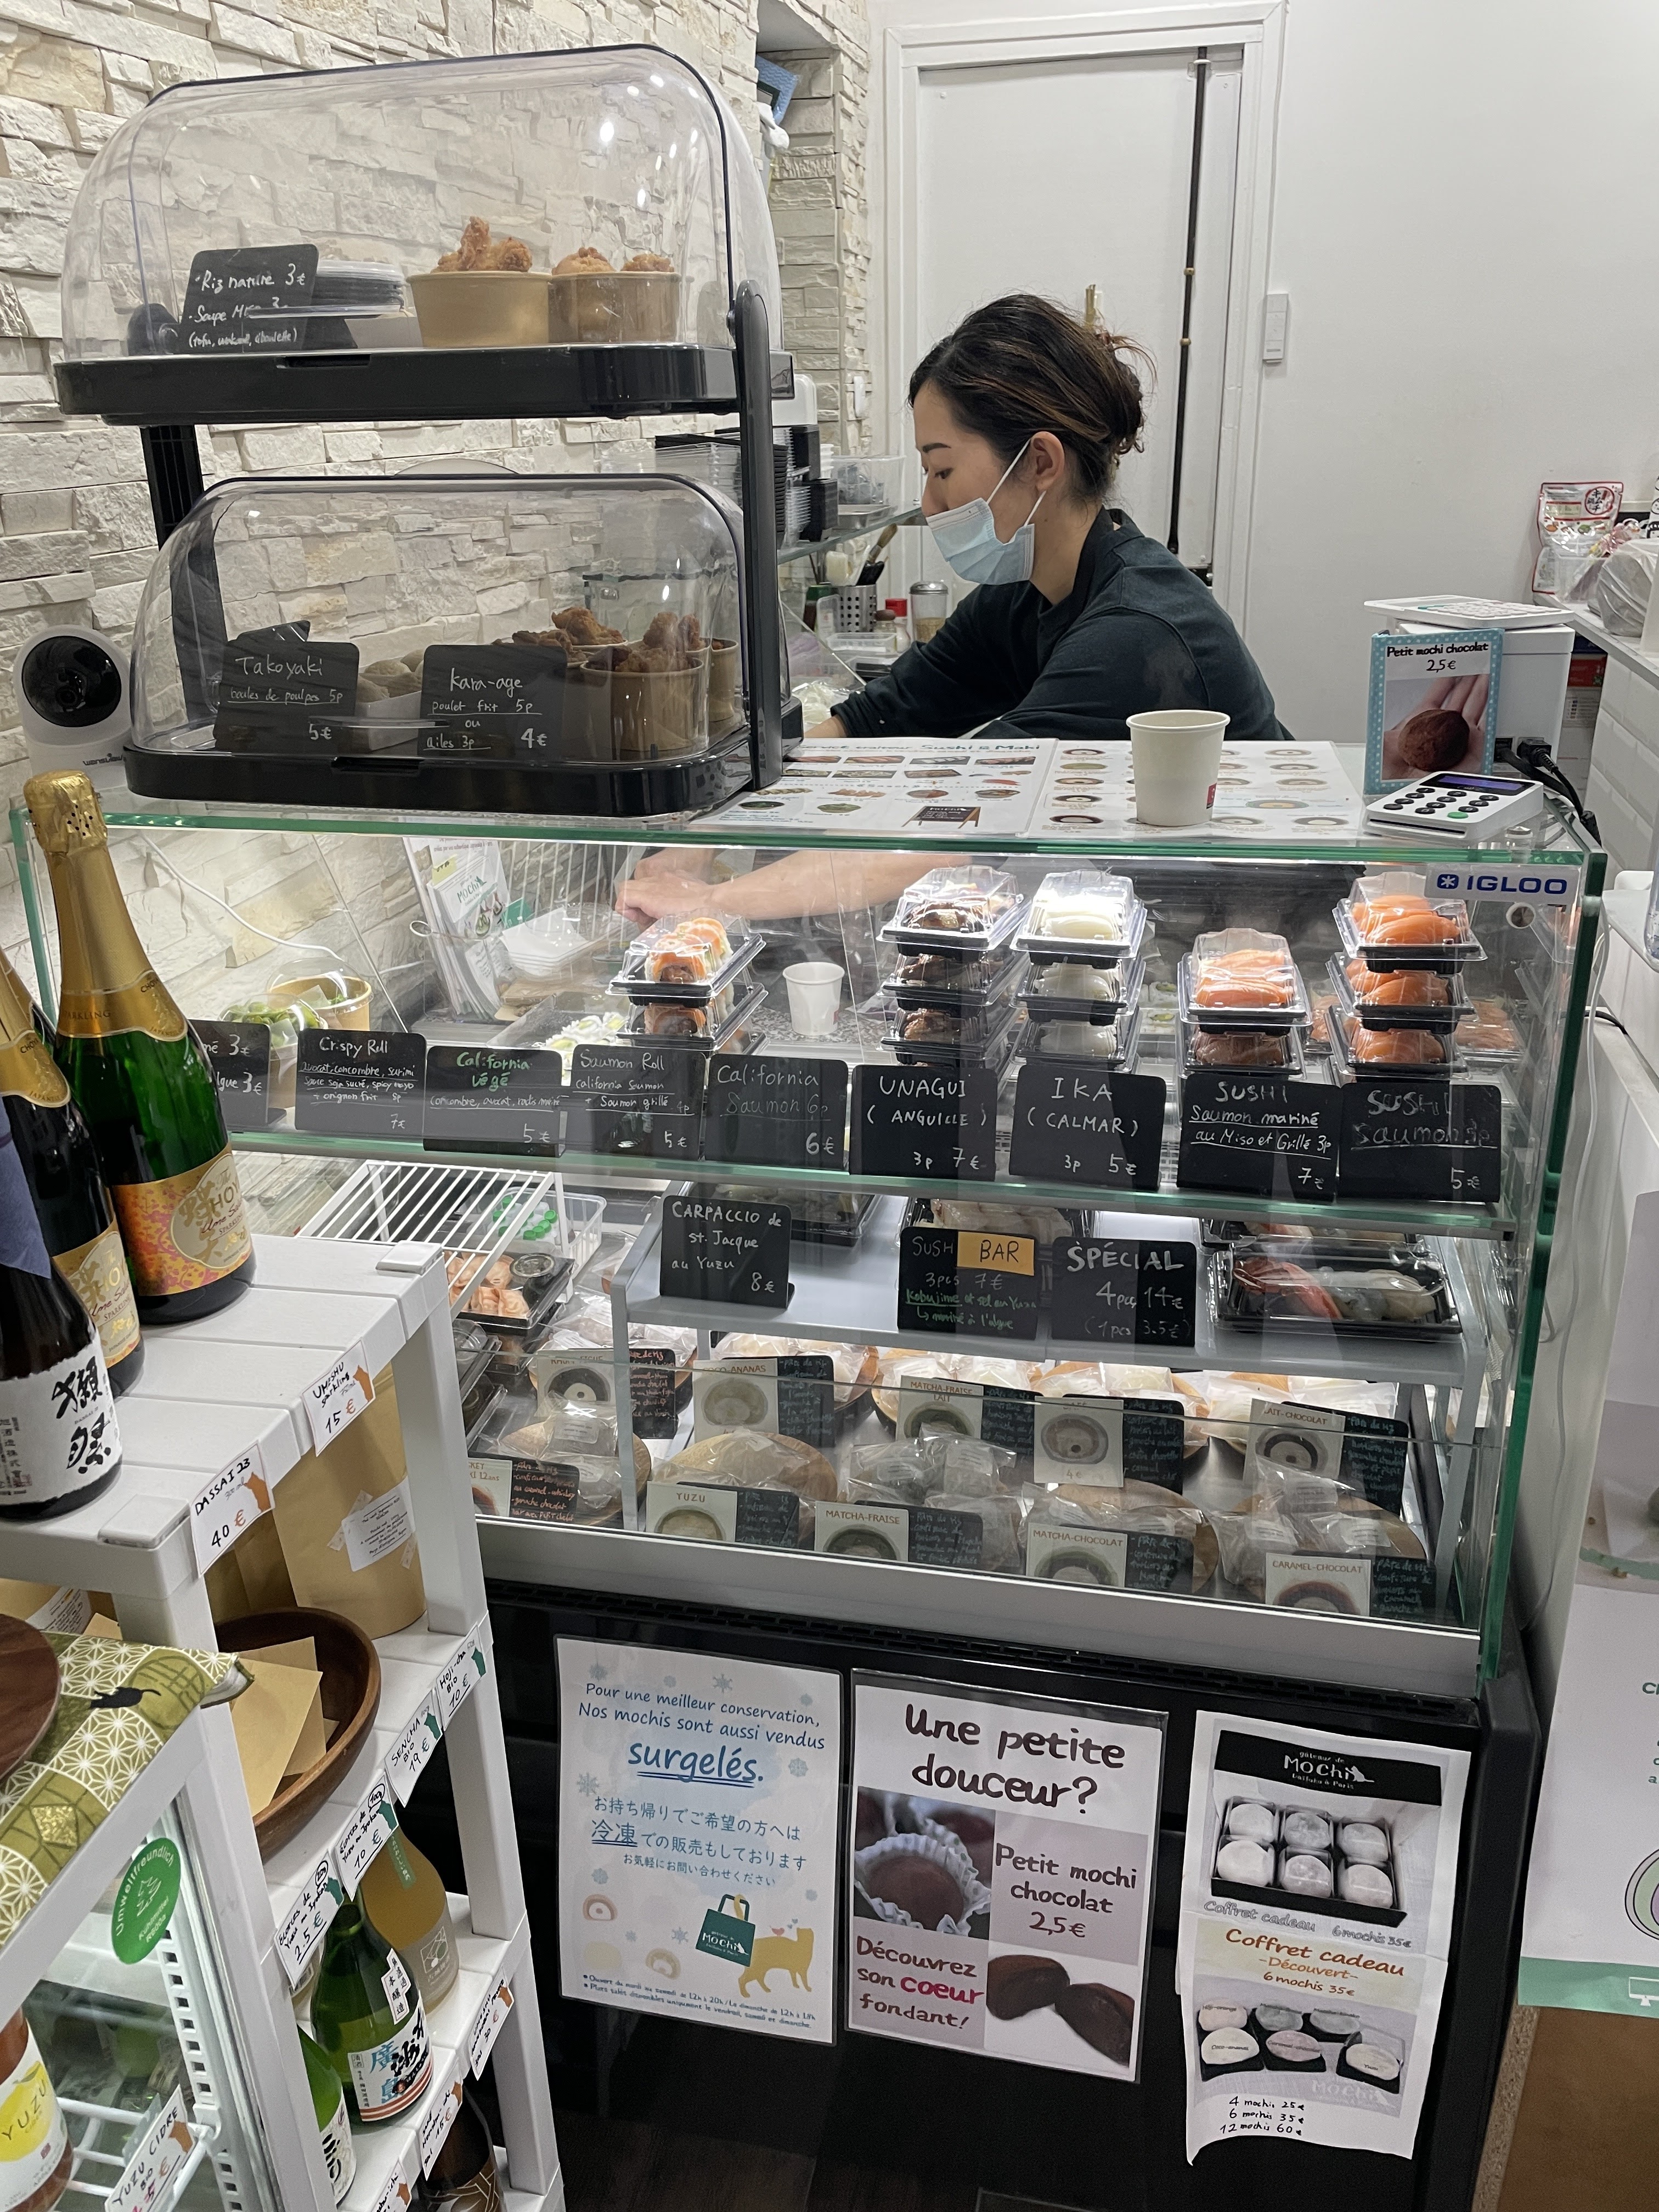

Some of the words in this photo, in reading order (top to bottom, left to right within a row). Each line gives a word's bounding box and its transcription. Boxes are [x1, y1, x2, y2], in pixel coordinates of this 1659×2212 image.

[1387, 646, 1414, 657] Petit
[1416, 644, 1444, 656] mochi
[1446, 641, 1489, 654] chocolat
[235, 654, 323, 680] Takoyaki
[1426, 658, 1457, 673] 2,5€
[432, 700, 466, 713] poulet
[477, 699, 498, 712] frit
[465, 719, 481, 727] ou
[1466, 874, 1567, 895] IGLOO
[456, 1051, 531, 1070] California
[580, 1049, 633, 1068] Saumon
[642, 1052, 664, 1070] Roll
[717, 1064, 819, 1086] California
[879, 1077, 968, 1097] UNAGUI
[1052, 1077, 1113, 1099] IKA
[1215, 1081, 1288, 1103] SUSHI
[726, 1092, 799, 1114] Saumon
[1191, 1105, 1252, 1124] Saumon
[1261, 1112, 1320, 1125] mariné
[1195, 1130, 1215, 1141] au
[1220, 1128, 1254, 1146] Miso
[1258, 1132, 1273, 1146] et
[672, 1201, 760, 1223] CARPACCIO
[768, 1212, 782, 1227] de
[712, 1230, 759, 1255] Jacque
[980, 1238, 1020, 1264] BAR
[672, 1260, 689, 1269] au
[697, 1256, 735, 1270] Yuzu
[1067, 1242, 1184, 1272] SPÉCIAL
[195, 1467, 235, 1516] DASSAI
[237, 1457, 251, 1475] 23
[676, 1492, 707, 1503] YUZU
[826, 1509, 901, 1525] MATCHA-FRAISE
[211, 1525, 230, 1548] 40
[1033, 1530, 1124, 1547] MATCHA-CHOCOLAT
[1272, 1560, 1363, 1574] CARAMEL-CHOCOLAT
[586, 1683, 620, 1699] Pour
[625, 1691, 651, 1703] une
[657, 1694, 715, 1712] meilleur
[720, 1701, 820, 1728] conservation,
[579, 1702, 608, 1719] Nos
[614, 1708, 671, 1729] mochis
[677, 1716, 713, 1734] sont
[720, 1724, 760, 1741] aussi
[766, 1729, 825, 1750] vendus
[905, 1703, 981, 1746] Une
[997, 1727, 1126, 1769] petite
[391, 1718, 420, 1767] SENCHA
[628, 1742, 764, 1782] surgelés.
[911, 1753, 1098, 1814] douceur?
[594, 1795, 800, 1842] お持ち帰りでご希望の方へは
[623, 1853, 776, 1887] お気軽にお問い合わせください
[995, 1843, 1059, 1876] Petit
[1070, 1865, 1137, 1889] mochi
[1010, 1881, 1113, 1914] chocolat
[1029, 1911, 1086, 1938] 2,5€
[1204, 1900, 1258, 1920] Coffret
[1261, 1912, 1316, 1933] cadeau
[856, 1935, 978, 1978] Découvrez
[1226, 1928, 1313, 1959] Coffret
[1319, 1950, 1405, 1976] cadeau
[857, 1966, 896, 1988] son
[900, 1976, 985, 2005] coeur
[1276, 1974, 1323, 1992] mochis
[859, 1993, 970, 2030] fondant!
[1, 2079, 48, 2142] YUZU
[1229, 2096, 1239, 2106] 4
[1229, 2108, 1237, 2119] 6
[112, 2162, 146, 2205] YUZU
[149, 2106, 179, 2156] CIDRE
